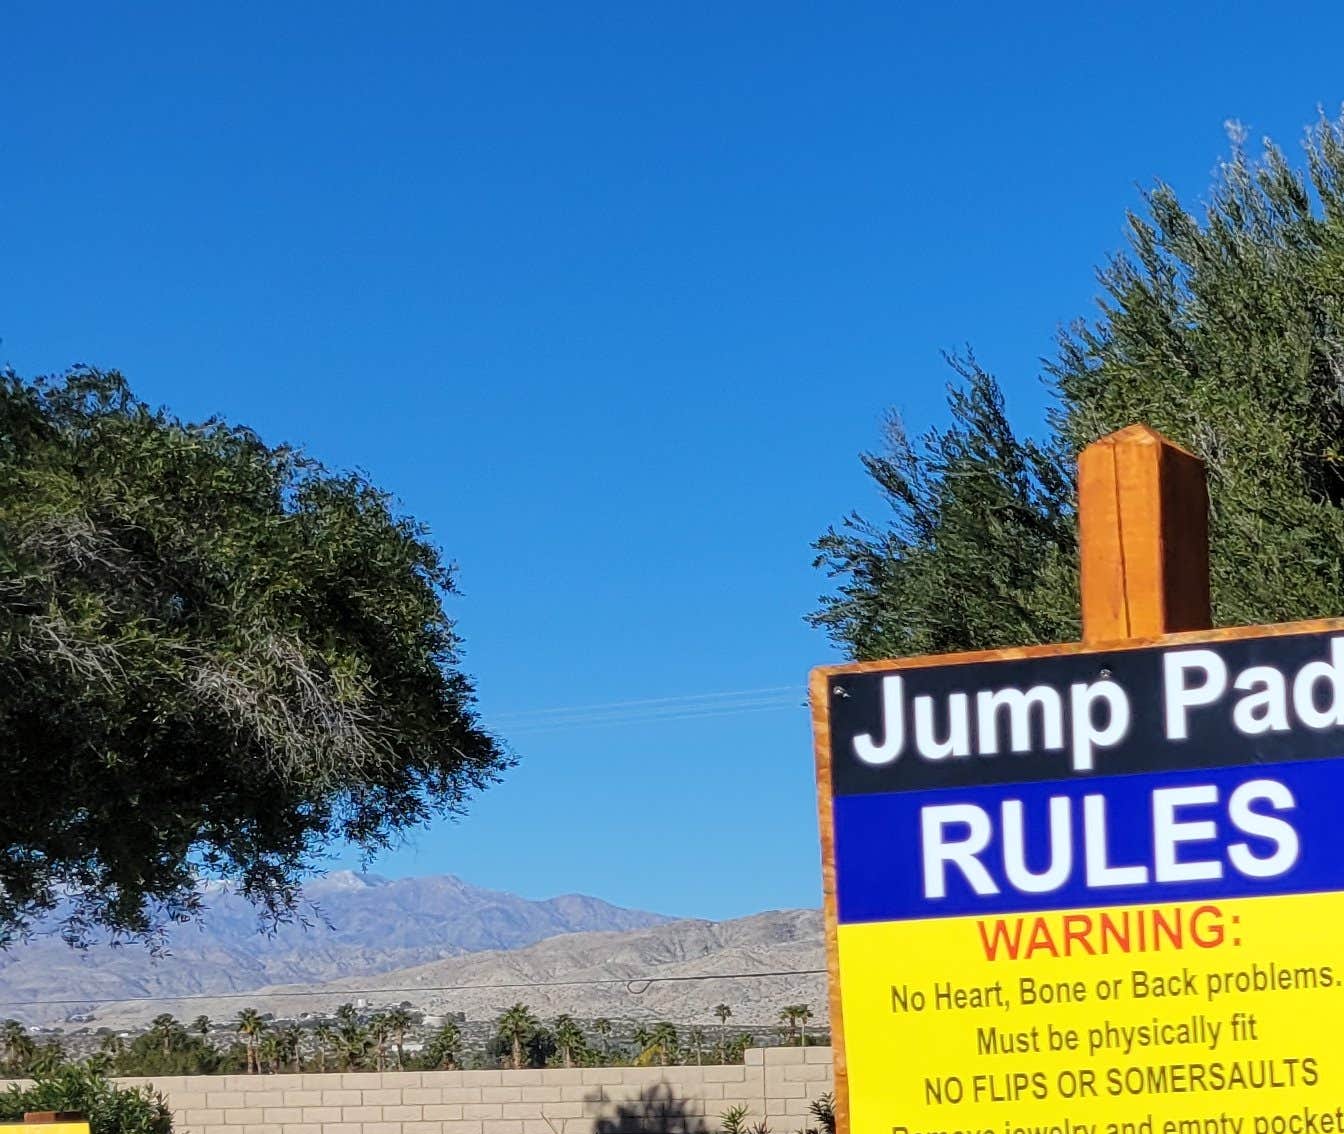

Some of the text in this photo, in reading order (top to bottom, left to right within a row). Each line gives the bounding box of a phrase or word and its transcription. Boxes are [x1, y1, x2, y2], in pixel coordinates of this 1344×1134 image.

[854, 676, 1129, 770] Jump
[922, 780, 1298, 904] RULES
[977, 905, 1240, 961] WARNING:
[891, 962, 1341, 1012] No Heart, Bone or Back problems.
[977, 1013, 1257, 1056] Must be physically fit
[925, 1058, 1318, 1105] NO FLIPS OR SOMERSAULTS
